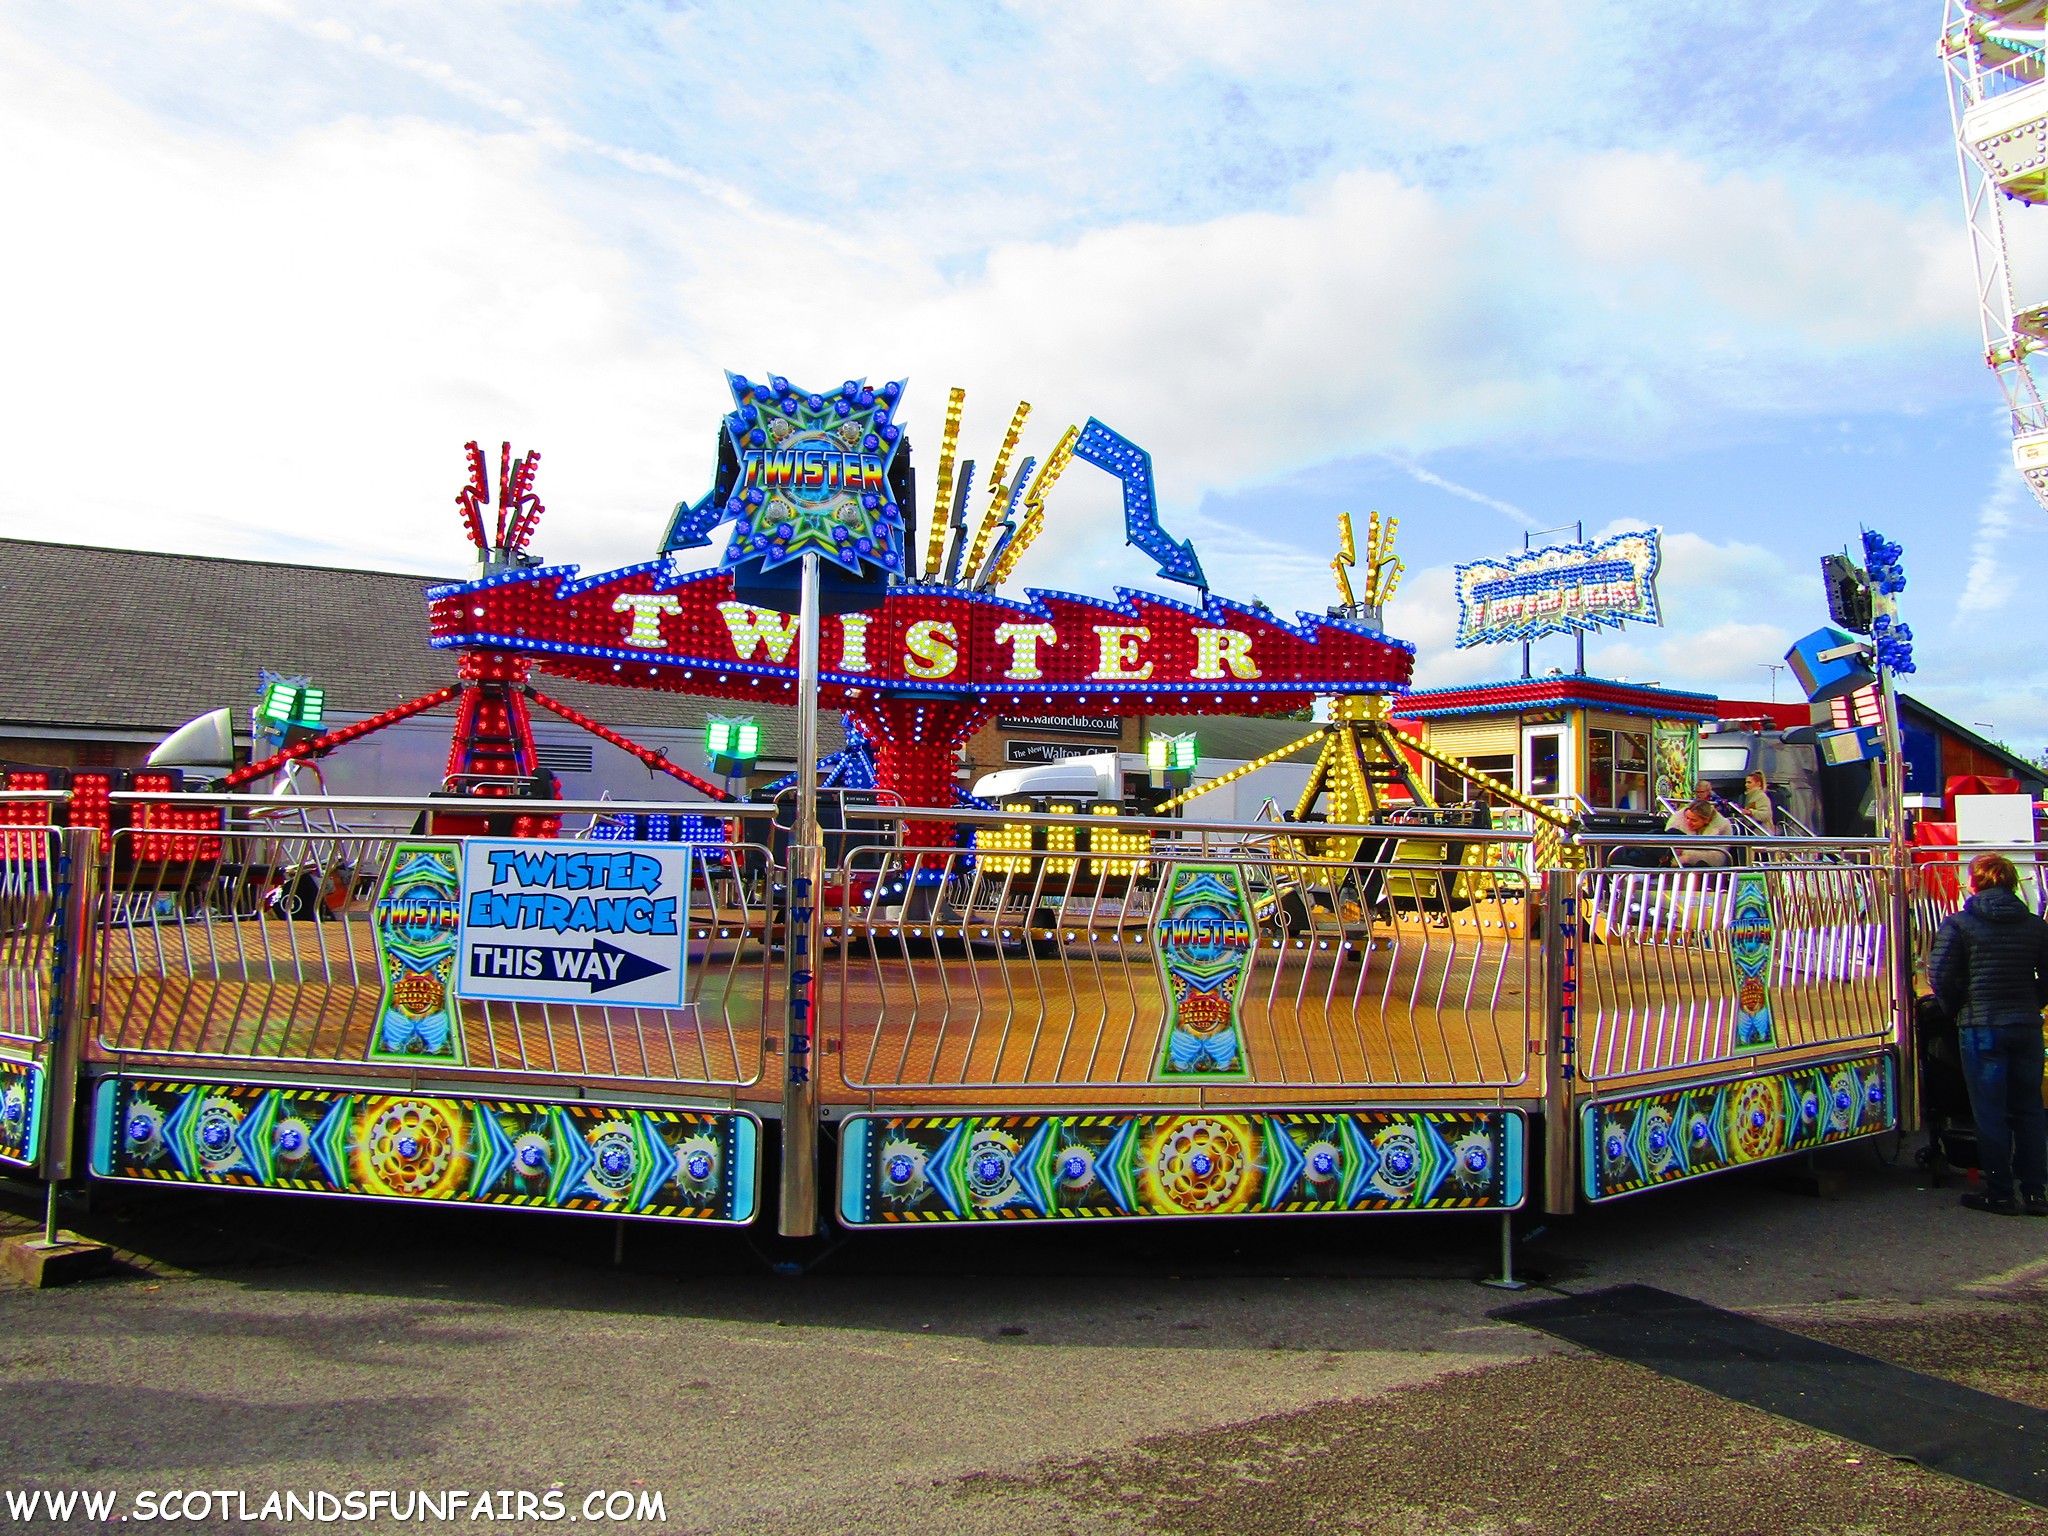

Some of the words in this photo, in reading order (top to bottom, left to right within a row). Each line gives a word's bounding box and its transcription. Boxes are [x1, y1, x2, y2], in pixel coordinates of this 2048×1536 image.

[742, 449, 884, 493] TWISTER
[1470, 560, 1638, 630] TWISTER
[612, 593, 1263, 679] TWISTER
[1013, 750, 1026, 759] The
[1027, 746, 1041, 755] New
[488, 849, 662, 895] TWISTER
[467, 889, 678, 936] ENTRANCE
[1159, 919, 1250, 948] TWISTER
[473, 946, 543, 978] THIS
[552, 950, 626, 982] WAY
[790, 878, 815, 1083] TWISTER
[1559, 898, 1577, 1080] TWISTER
